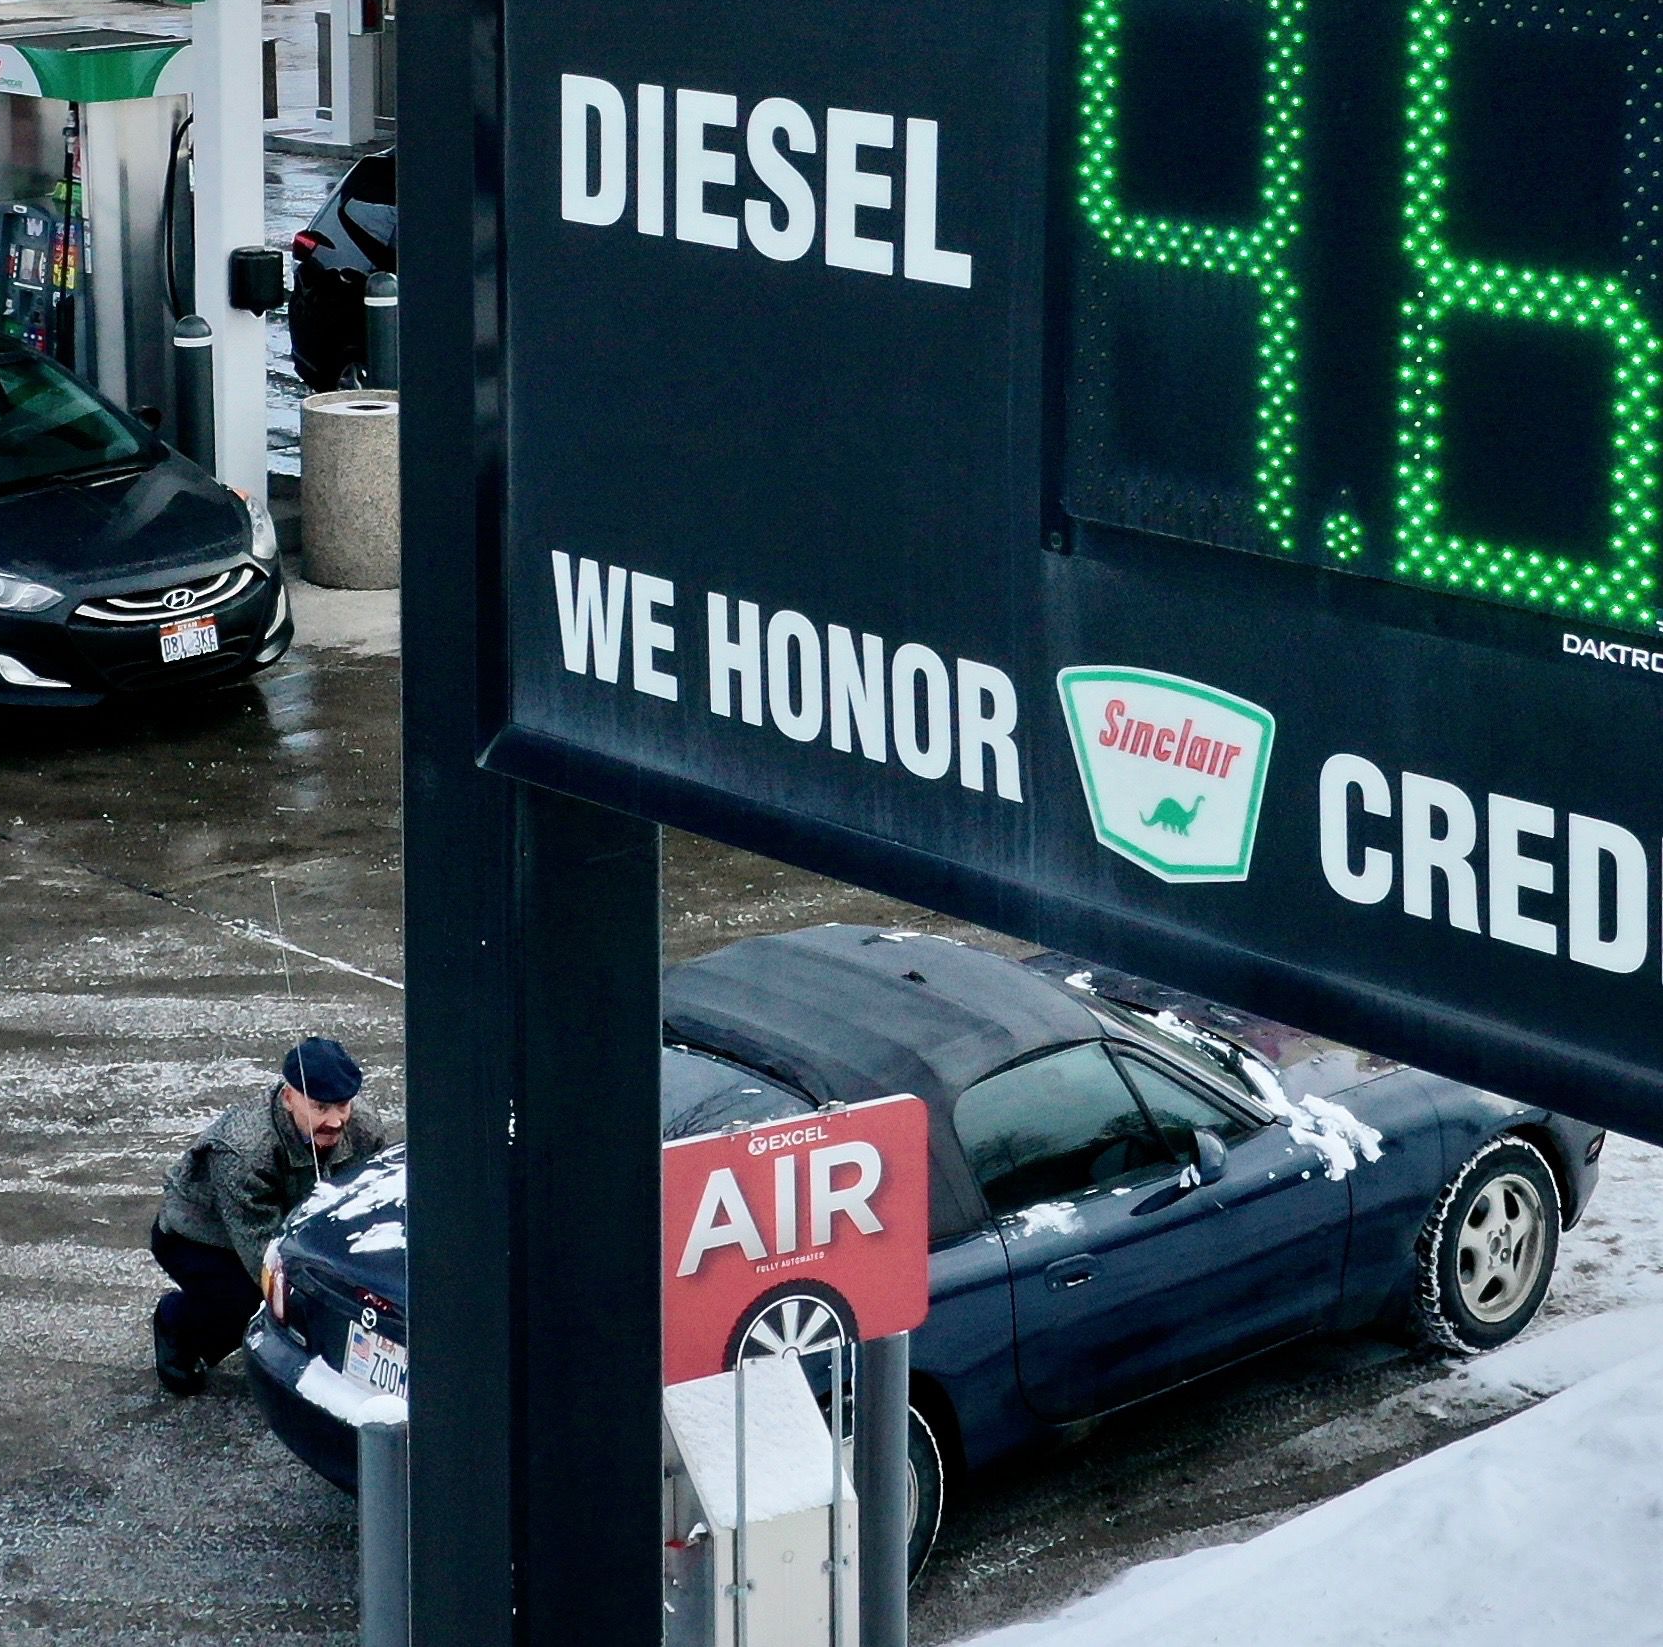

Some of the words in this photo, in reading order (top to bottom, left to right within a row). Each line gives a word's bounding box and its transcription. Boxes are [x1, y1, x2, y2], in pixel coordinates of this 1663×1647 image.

[561, 73, 972, 289] DIESEL
[551, 549, 678, 702] WE
[707, 591, 1024, 804] HONOR
[1098, 699, 1242, 779] Sinclair
[769, 1126, 829, 1151] EXCEL
[676, 1141, 884, 1277] AIR
[756, 1261, 779, 1274] FULLY
[781, 1251, 825, 1269] AUTOMATED
